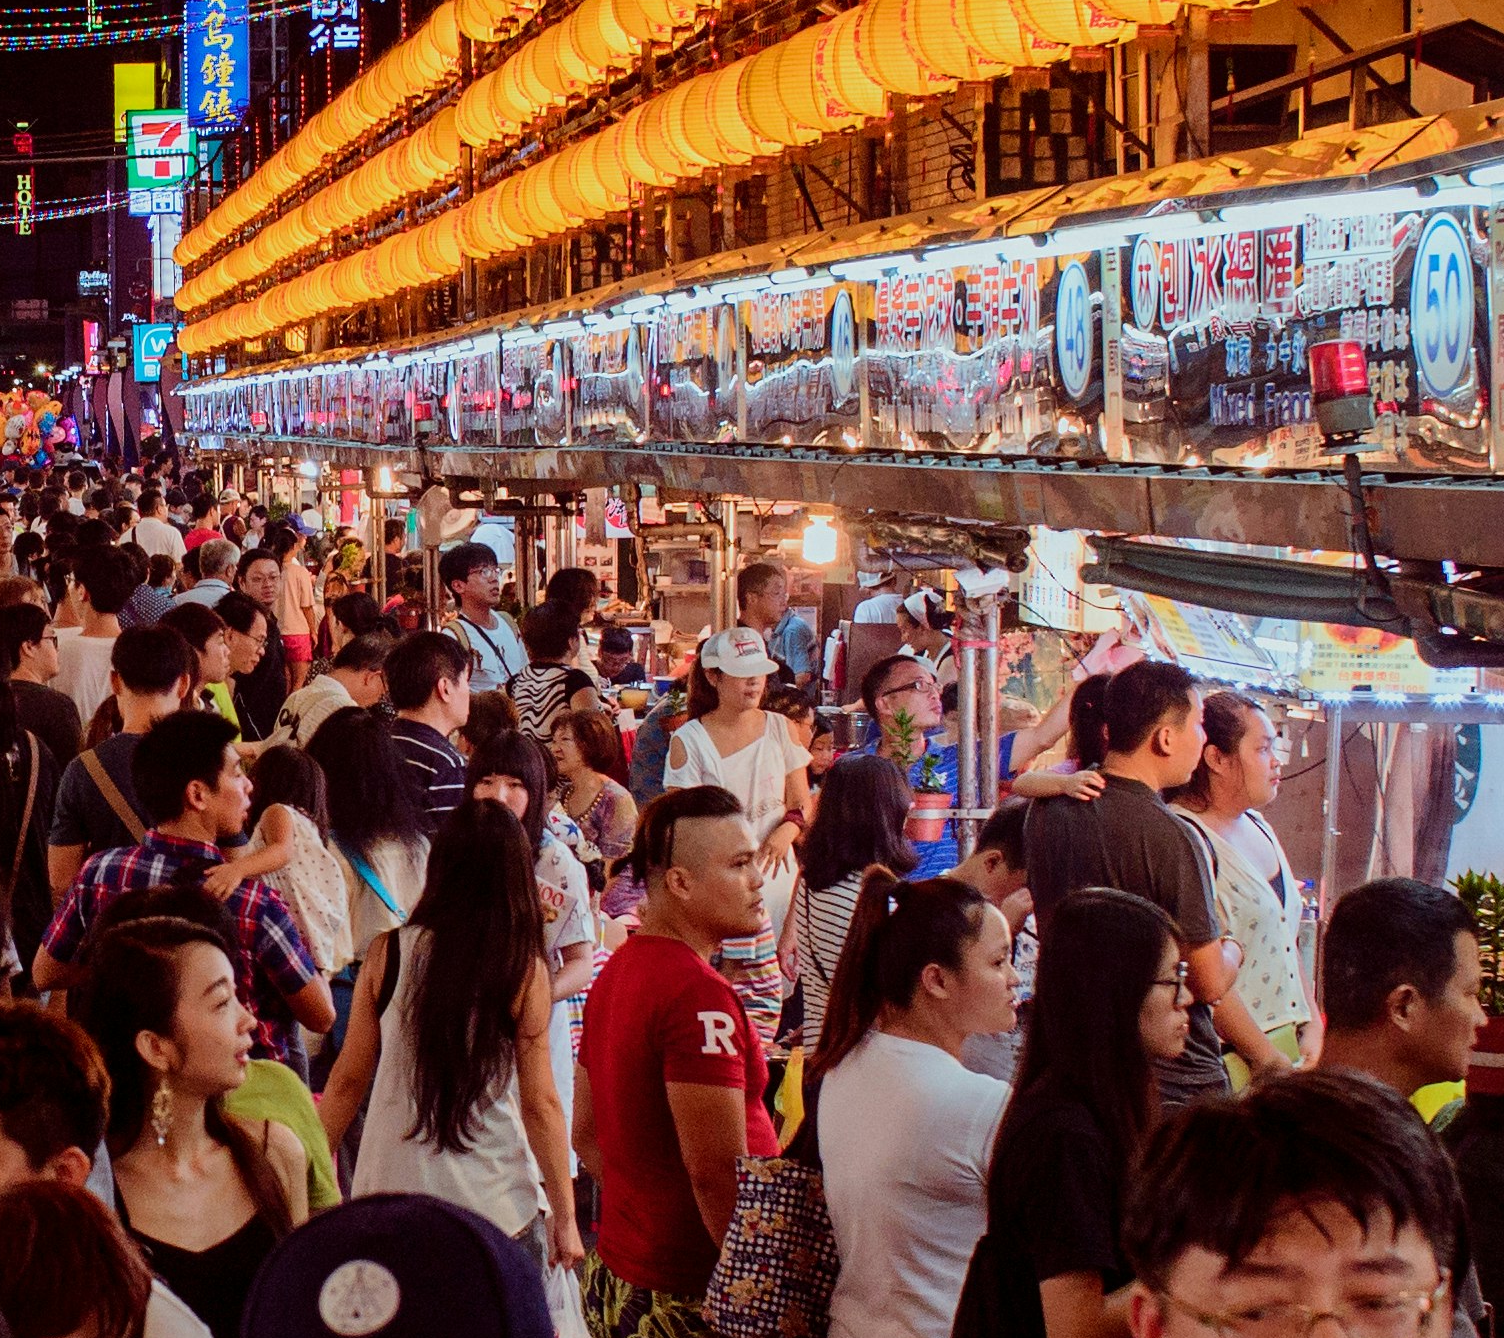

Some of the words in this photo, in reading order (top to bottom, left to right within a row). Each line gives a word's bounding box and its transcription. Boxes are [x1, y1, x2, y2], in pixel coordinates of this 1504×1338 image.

[1064, 285, 1086, 374] 48
[1427, 253, 1461, 364] 50
[698, 1010, 739, 1055] R
